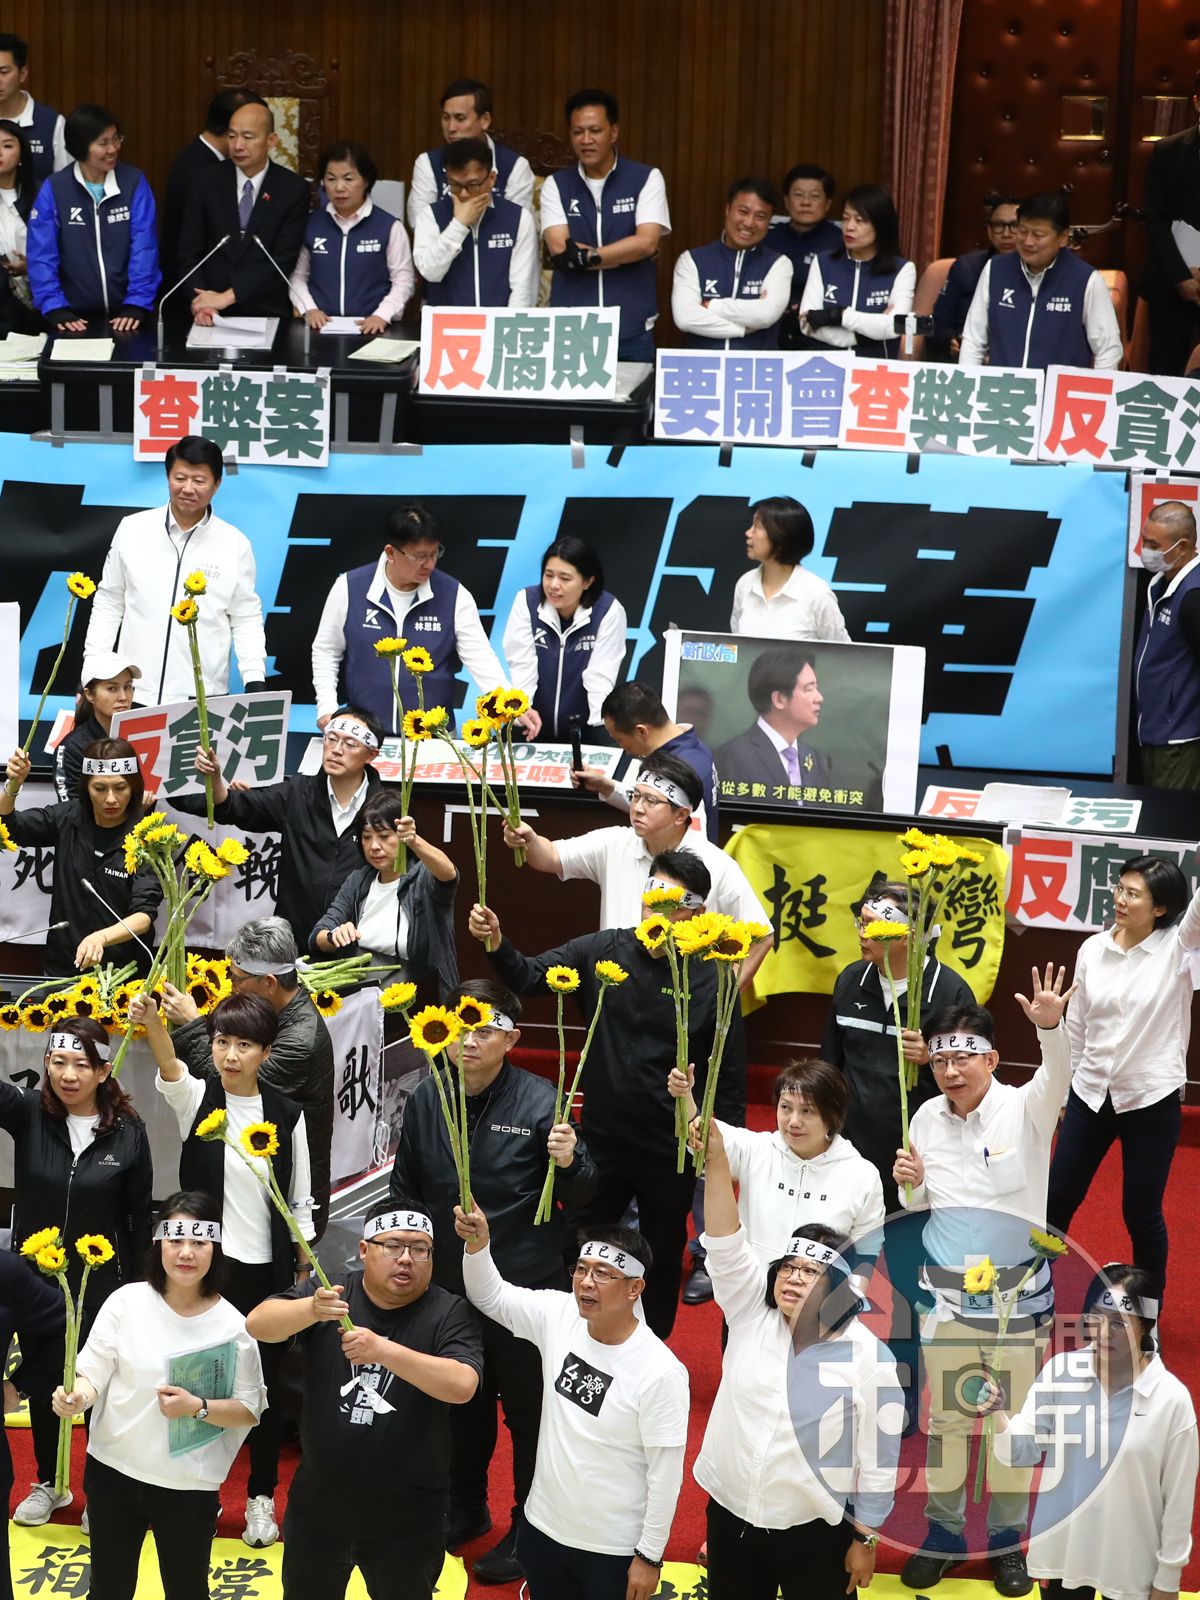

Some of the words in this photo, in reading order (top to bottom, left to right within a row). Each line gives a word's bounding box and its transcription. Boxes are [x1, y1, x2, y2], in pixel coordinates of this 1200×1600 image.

[424, 312, 613, 391] 反腐敗
[139, 374, 324, 460] 查弊案
[659, 355, 846, 439] 要開會
[846, 364, 1038, 455] 查弊案
[117, 699, 286, 795] 反貪污
[328, 719, 371, 745] 民主已死
[86, 759, 131, 773] 民主已死
[773, 783, 864, 806] 才能避免衝突
[763, 864, 1002, 969] 挺灣
[490, 1123, 531, 1136] 2020
[162, 1221, 216, 1240] 民主已死
[374, 1214, 431, 1233] 民主已死
